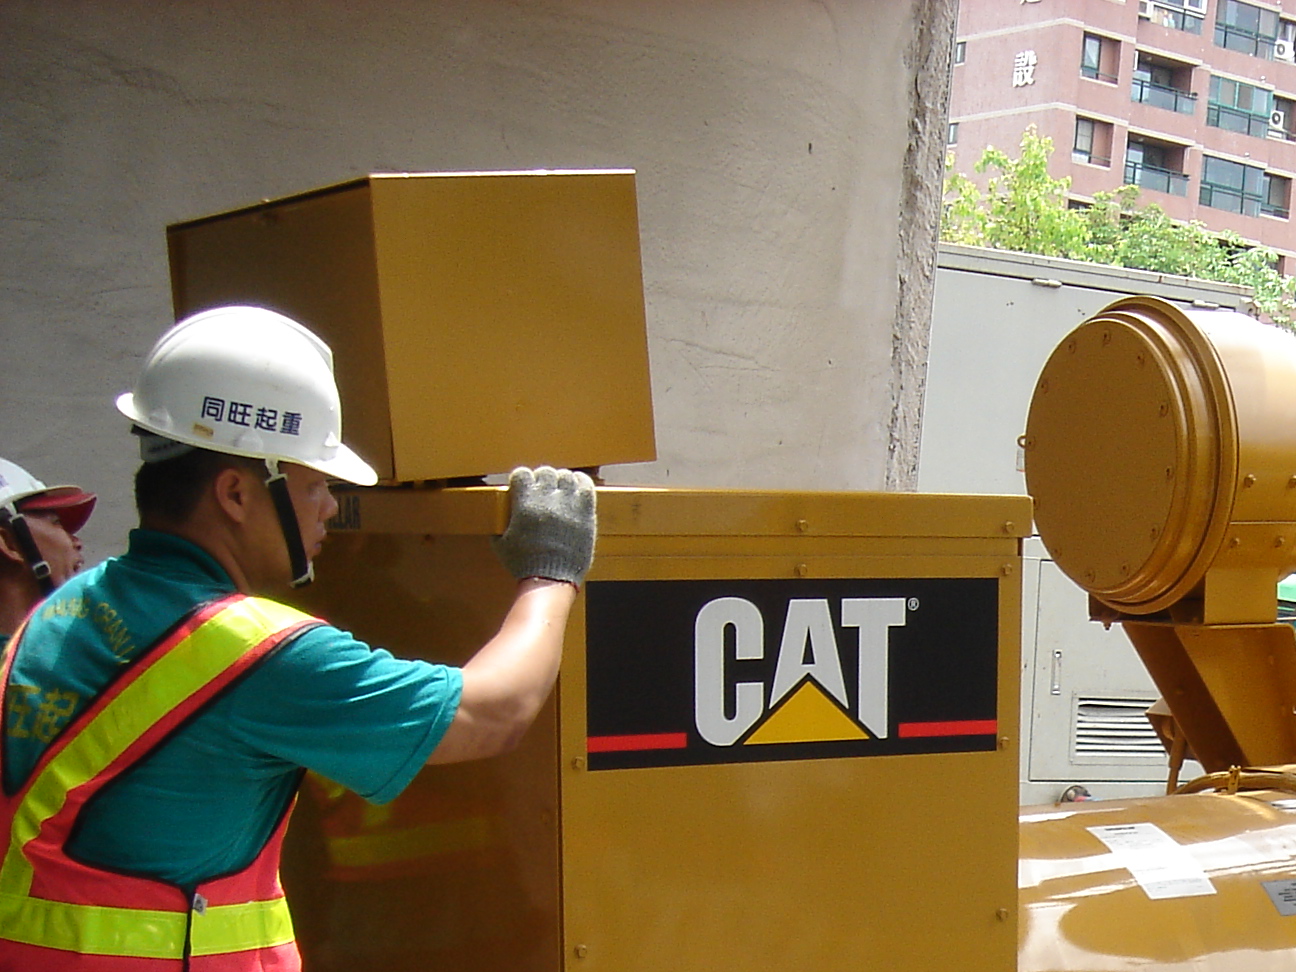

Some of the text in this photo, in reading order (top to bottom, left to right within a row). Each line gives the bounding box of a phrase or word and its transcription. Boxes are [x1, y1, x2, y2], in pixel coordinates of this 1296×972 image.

[201, 396, 302, 436] 同旺起重
[695, 597, 907, 747] CAT
